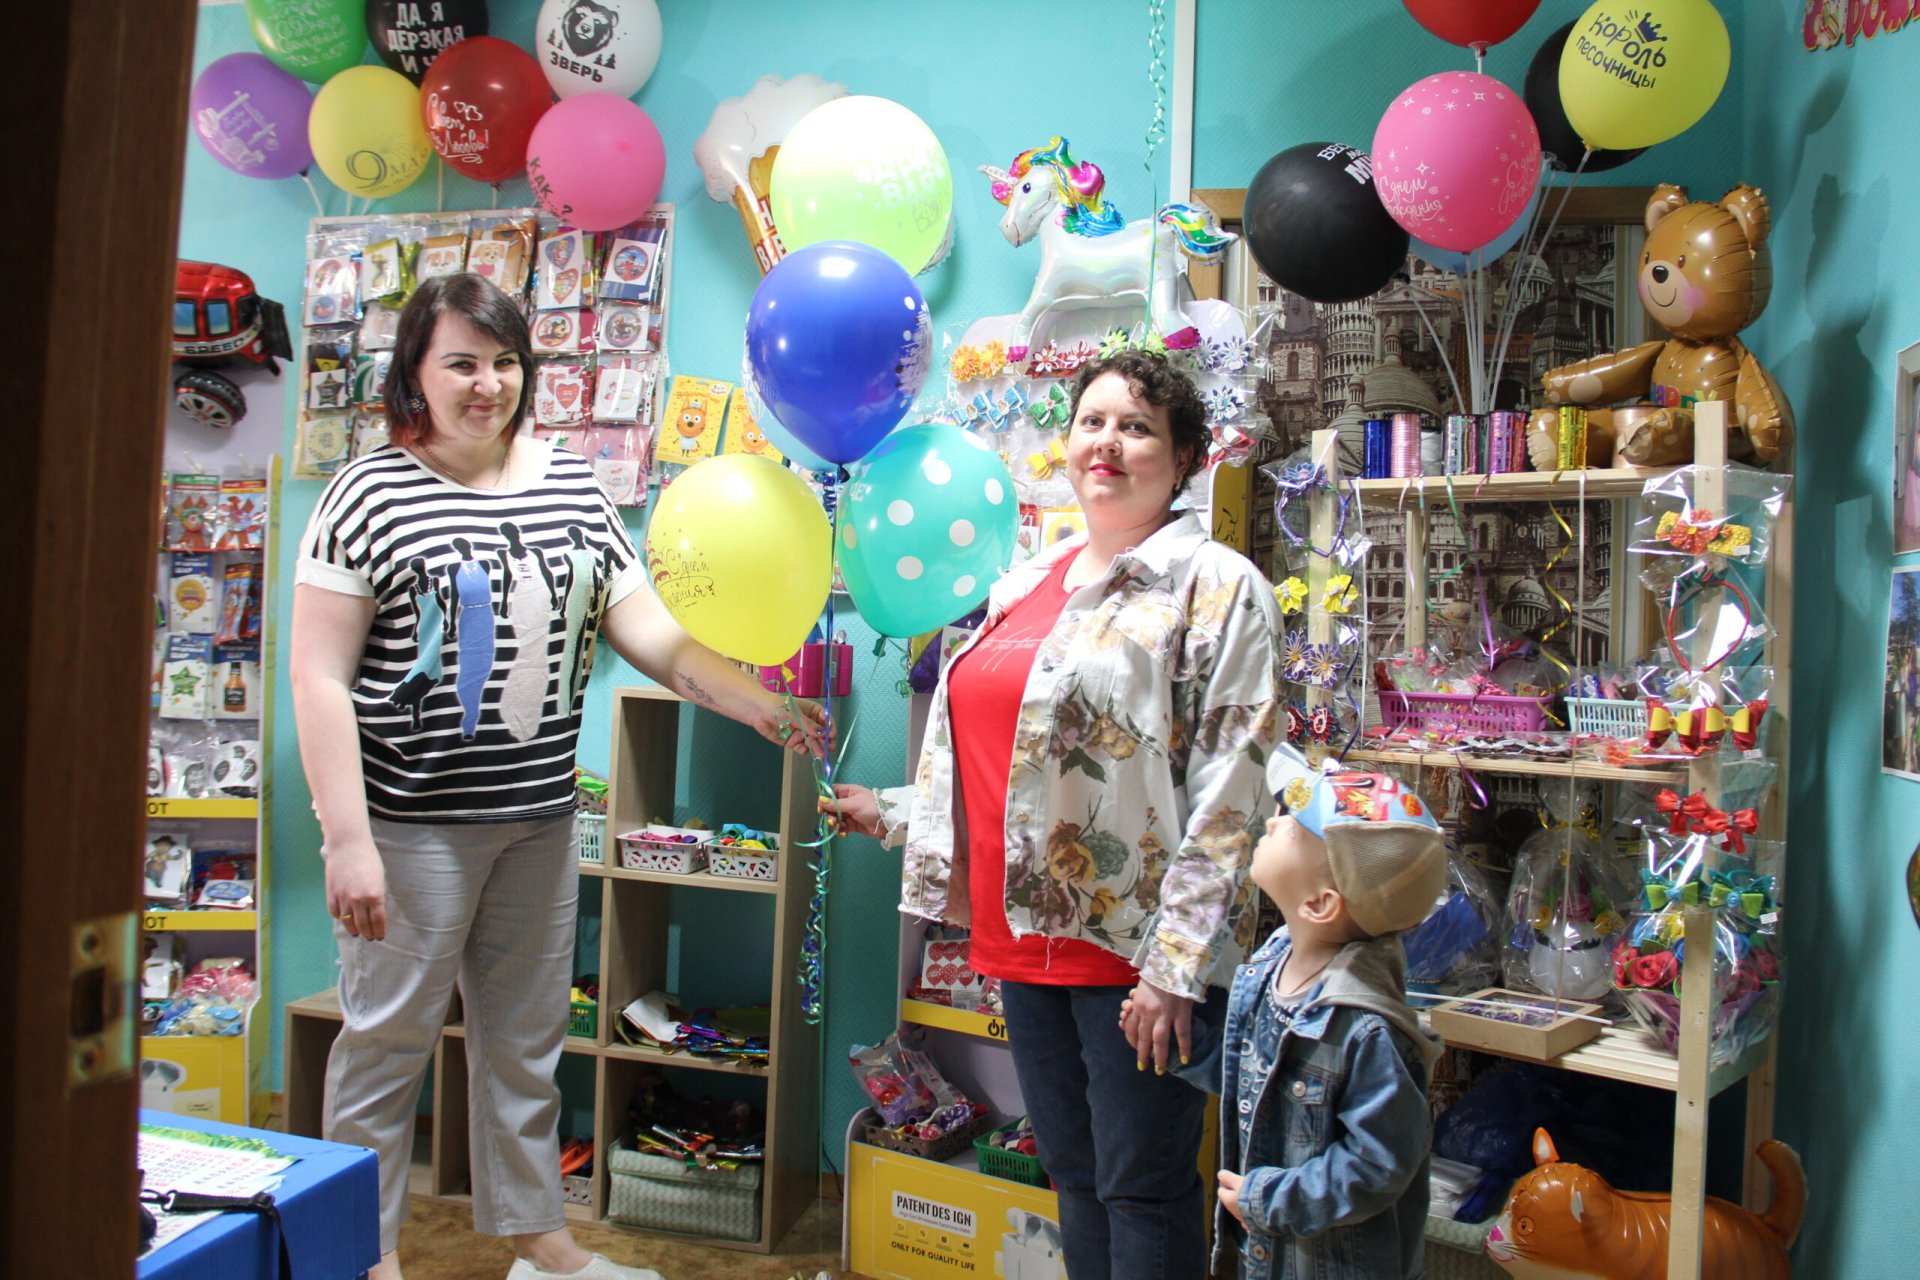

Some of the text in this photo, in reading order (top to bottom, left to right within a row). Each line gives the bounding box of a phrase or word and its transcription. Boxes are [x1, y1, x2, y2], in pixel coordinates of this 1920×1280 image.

[396, 1, 445, 29] ДА, Я
[387, 25, 465, 53] ДЕРЗКАЯ
[401, 53, 419, 74] И
[551, 51, 604, 84] ЗВЕРЬ
[346, 149, 387, 189] 9
[897, 1195, 930, 1215] PATENT
[891, 1240, 909, 1252] ONLY
[911, 1246, 926, 1257] FOR
[927, 1251, 959, 1266] QUALITY
[960, 1259, 976, 1272] LIFE
